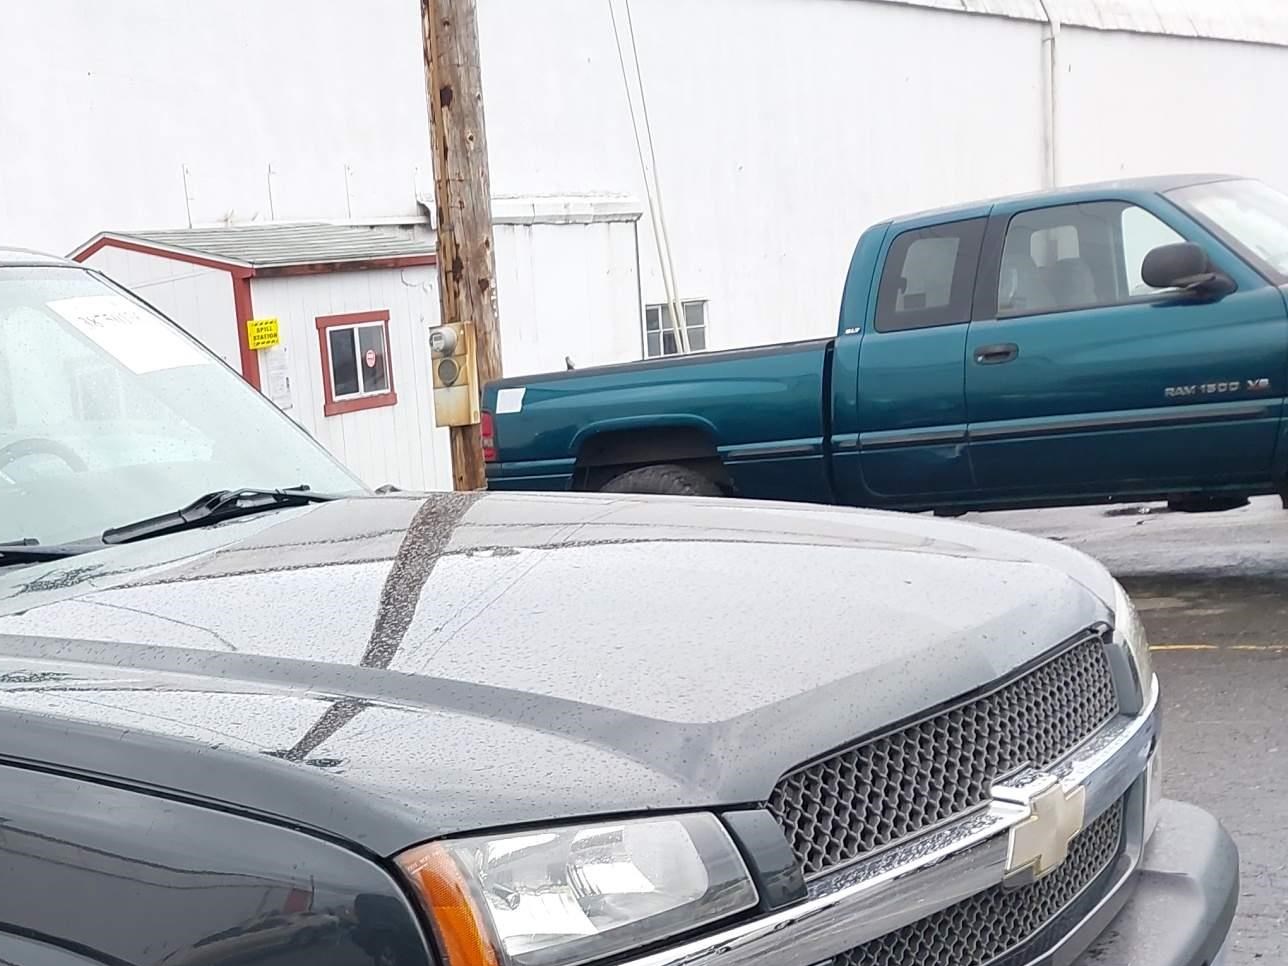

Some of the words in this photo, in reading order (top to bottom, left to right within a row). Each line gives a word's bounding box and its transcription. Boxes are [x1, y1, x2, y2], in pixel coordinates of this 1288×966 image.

[256, 326, 273, 334] SPILL
[253, 332, 278, 341] STATION
[1165, 385, 1196, 397] RAM
[1201, 381, 1240, 394] 1500
